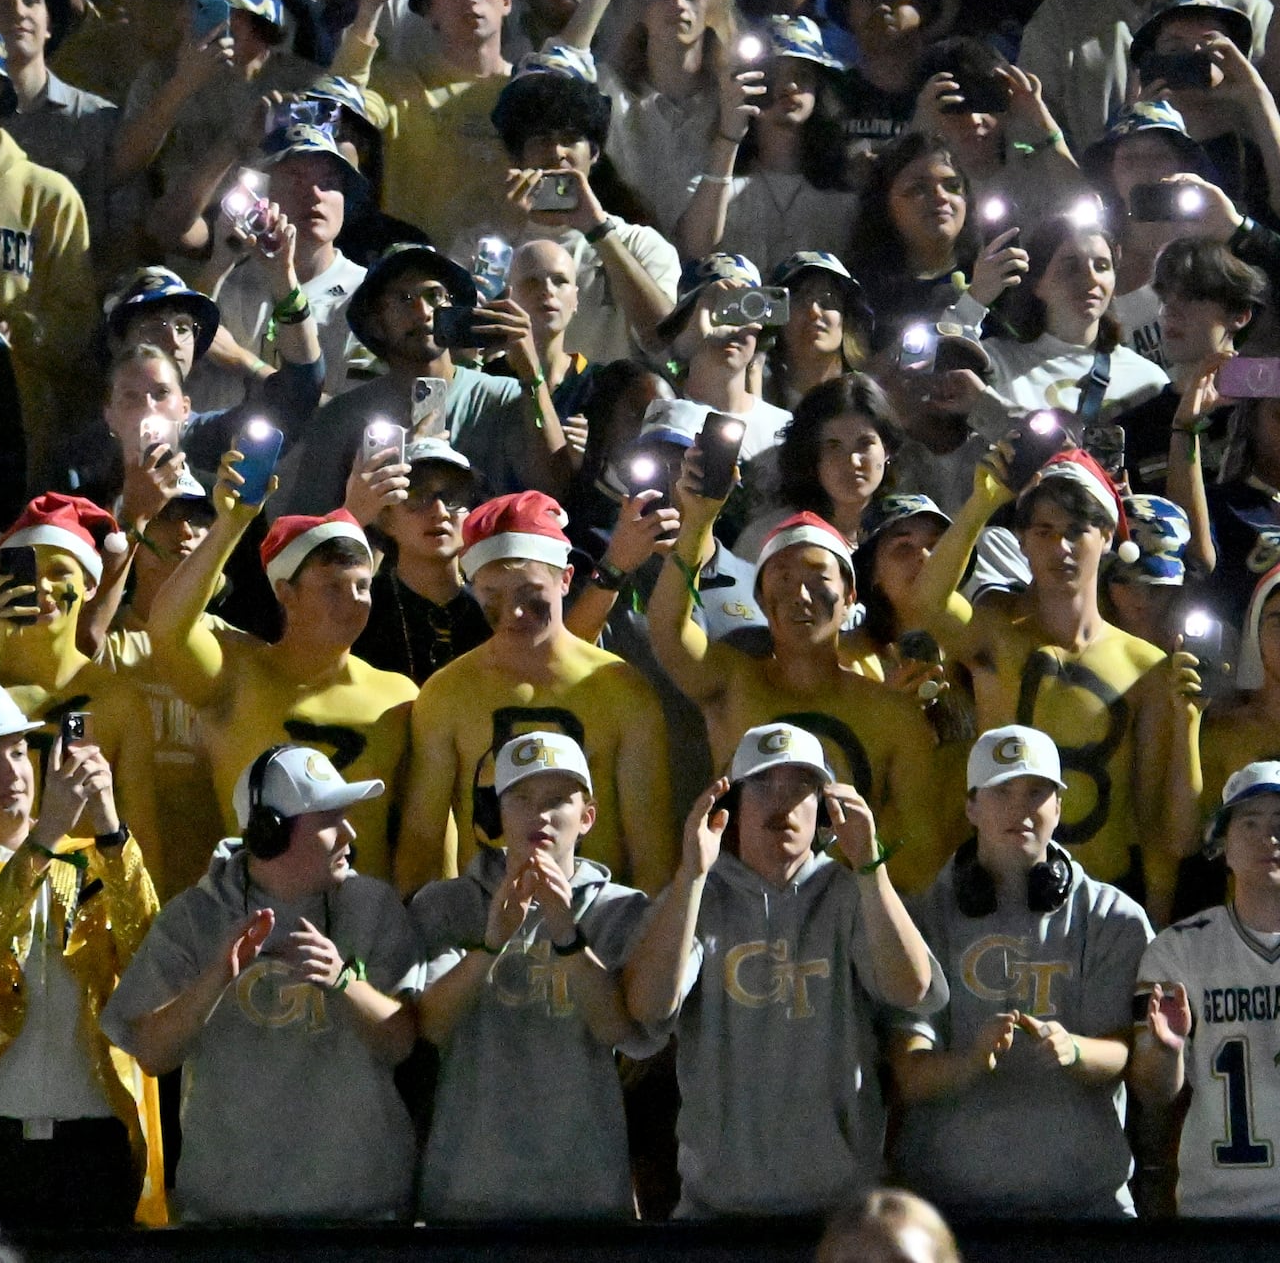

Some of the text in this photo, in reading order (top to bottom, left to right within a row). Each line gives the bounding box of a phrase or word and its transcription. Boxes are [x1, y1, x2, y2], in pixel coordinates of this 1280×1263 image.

[511, 738, 560, 768] GT
[722, 938, 830, 1020] GT
[960, 933, 1072, 1017] GT
